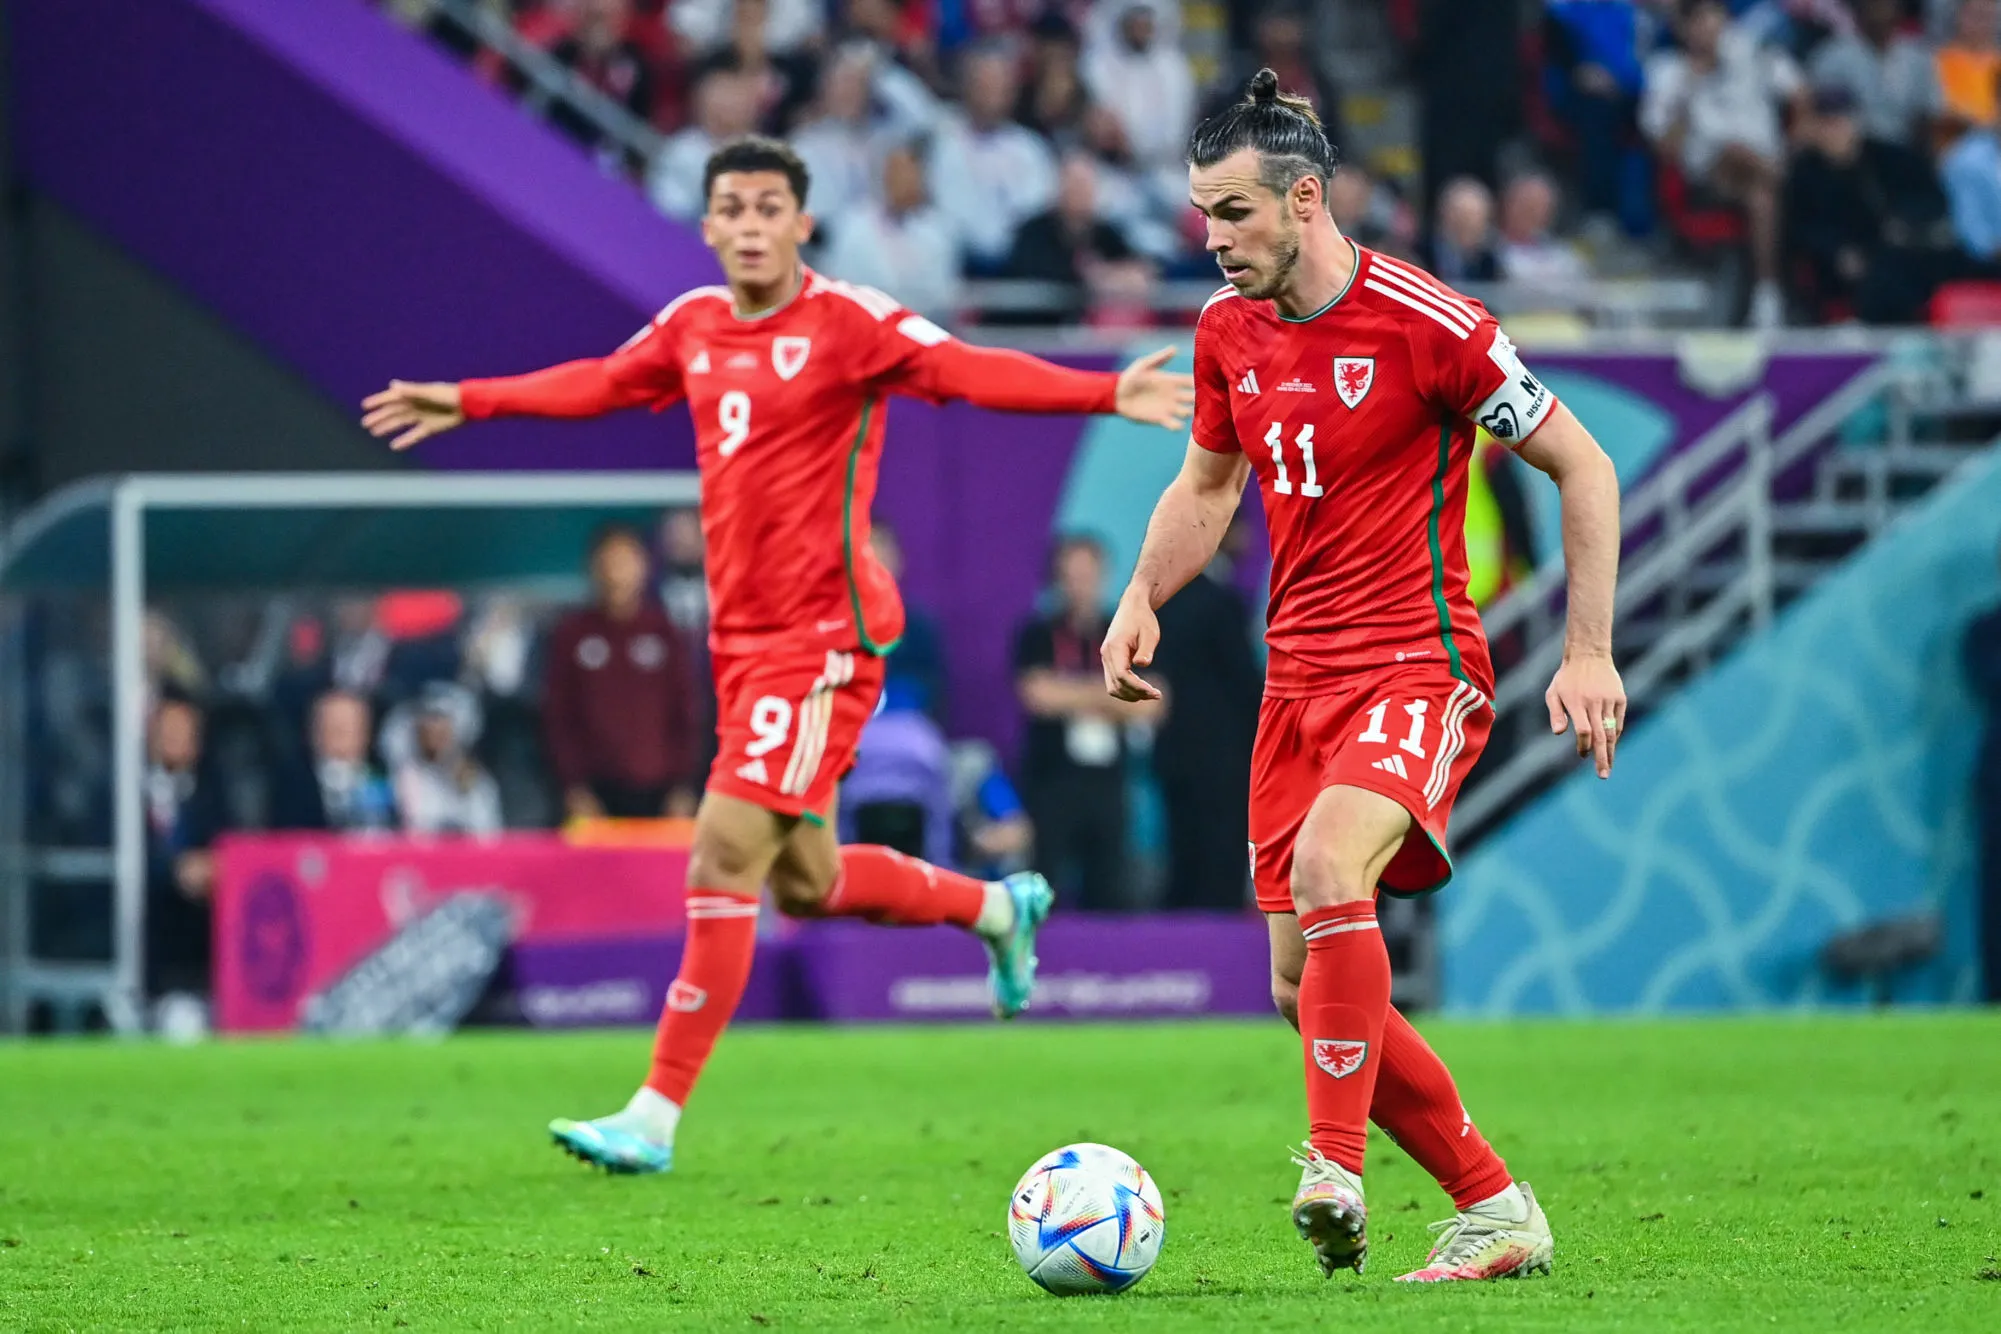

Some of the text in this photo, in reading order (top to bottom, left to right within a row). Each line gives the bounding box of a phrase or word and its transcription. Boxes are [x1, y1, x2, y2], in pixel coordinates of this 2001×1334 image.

[718, 391, 751, 456] 9
[1263, 421, 1324, 498] 11
[745, 695, 792, 757] 9
[1357, 698, 1428, 759] 11
